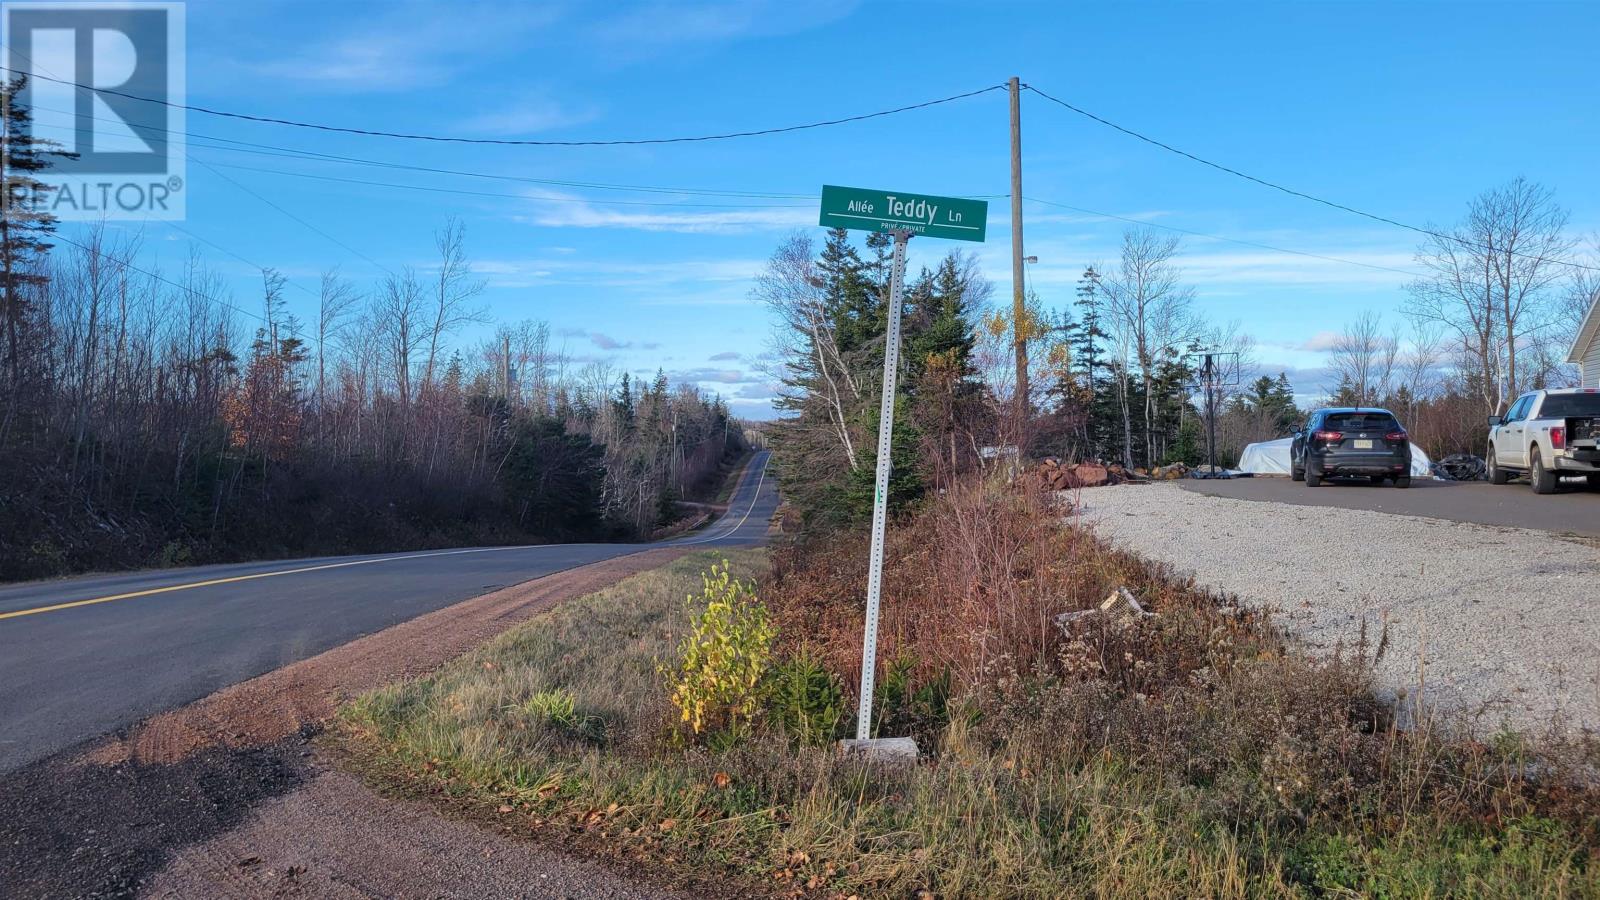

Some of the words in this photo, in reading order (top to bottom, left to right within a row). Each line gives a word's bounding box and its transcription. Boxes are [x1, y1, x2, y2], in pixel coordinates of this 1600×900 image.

[847, 200, 874, 214] Allée
[886, 196, 938, 225] Teddy
[948, 210, 962, 222] Ln
